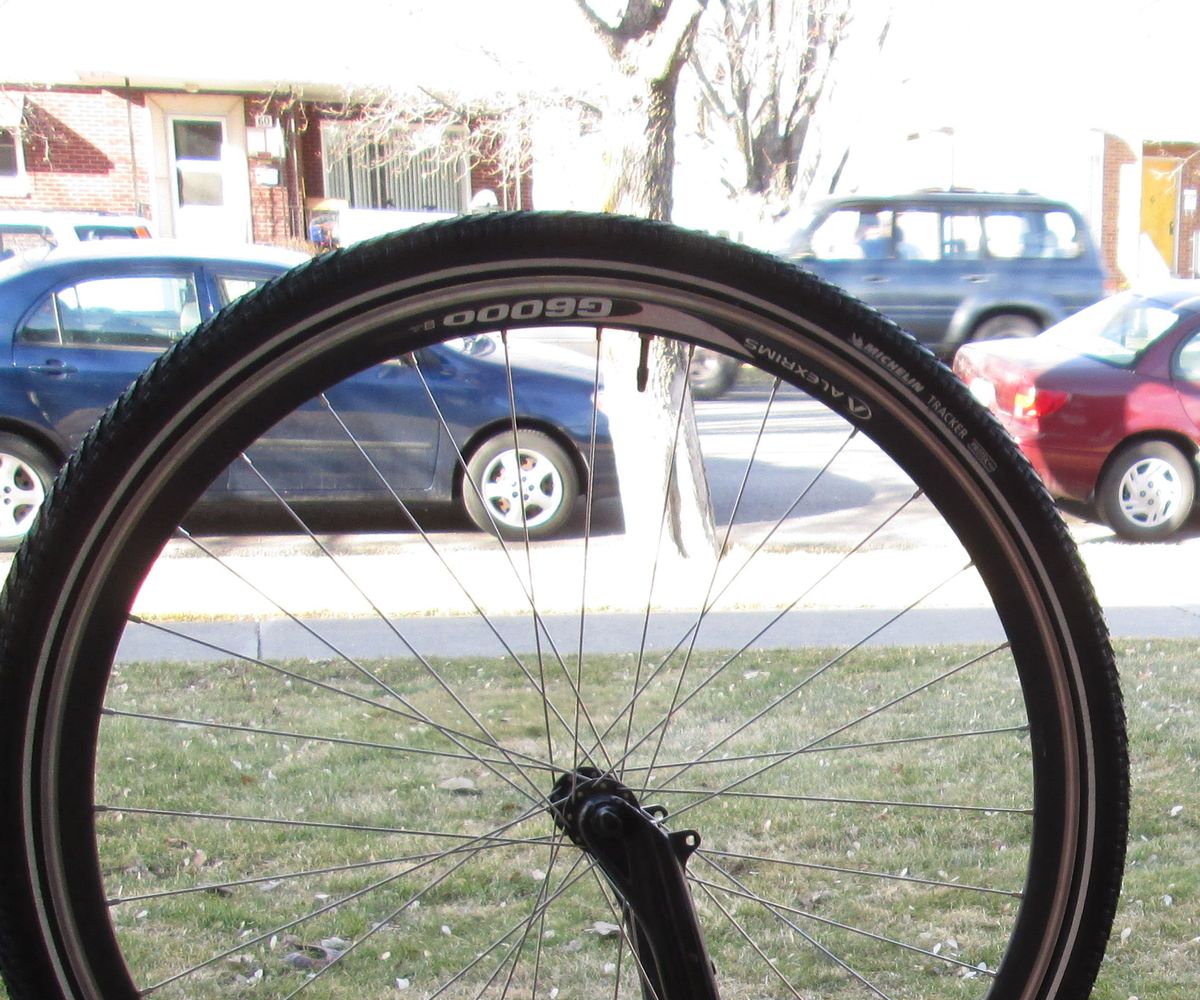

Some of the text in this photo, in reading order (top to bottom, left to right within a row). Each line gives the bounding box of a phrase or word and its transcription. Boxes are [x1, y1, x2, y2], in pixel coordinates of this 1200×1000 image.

[443, 297, 613, 326] G6000
[742, 337, 844, 398] ALEXRIMS
[863, 343, 968, 440] MICHELIN TRACKER
